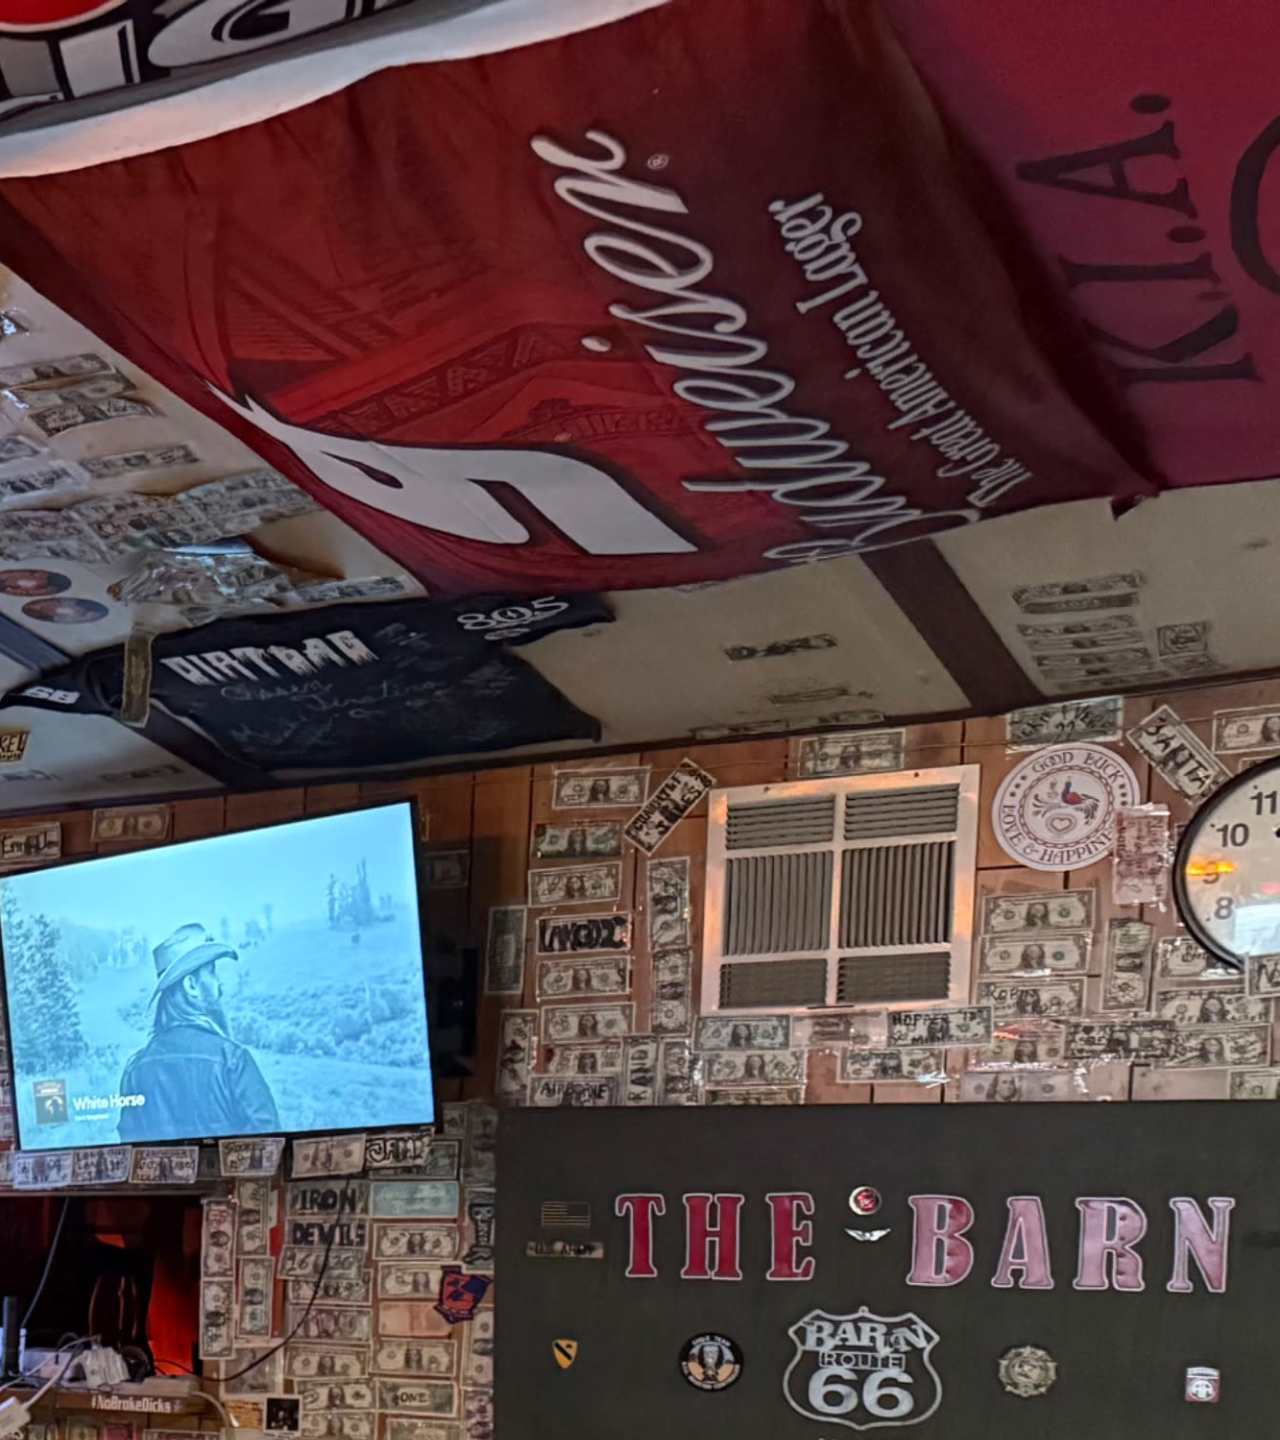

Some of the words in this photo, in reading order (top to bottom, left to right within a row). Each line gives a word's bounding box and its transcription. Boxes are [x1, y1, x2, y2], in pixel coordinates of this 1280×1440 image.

[769, 192, 865, 312] Lager
[530, 128, 985, 560] Budweiser
[832, 298, 957, 443] American
[931, 415, 1006, 482] Great
[1032, 751, 1075, 774] GOOD
[1251, 791, 1278, 816] 11
[1216, 823, 1249, 848] 10
[1215, 897, 1234, 920] 8
[109, 1093, 146, 1108] Horse
[296, 1187, 358, 1213] IRON
[292, 1223, 366, 1247] DEVILS
[615, 1191, 818, 1282] THE
[907, 1193, 1237, 1293] BARN
[803, 1319, 928, 1352] BARN
[824, 1351, 904, 1371] ROUTE
[808, 1366, 915, 1418] 66
